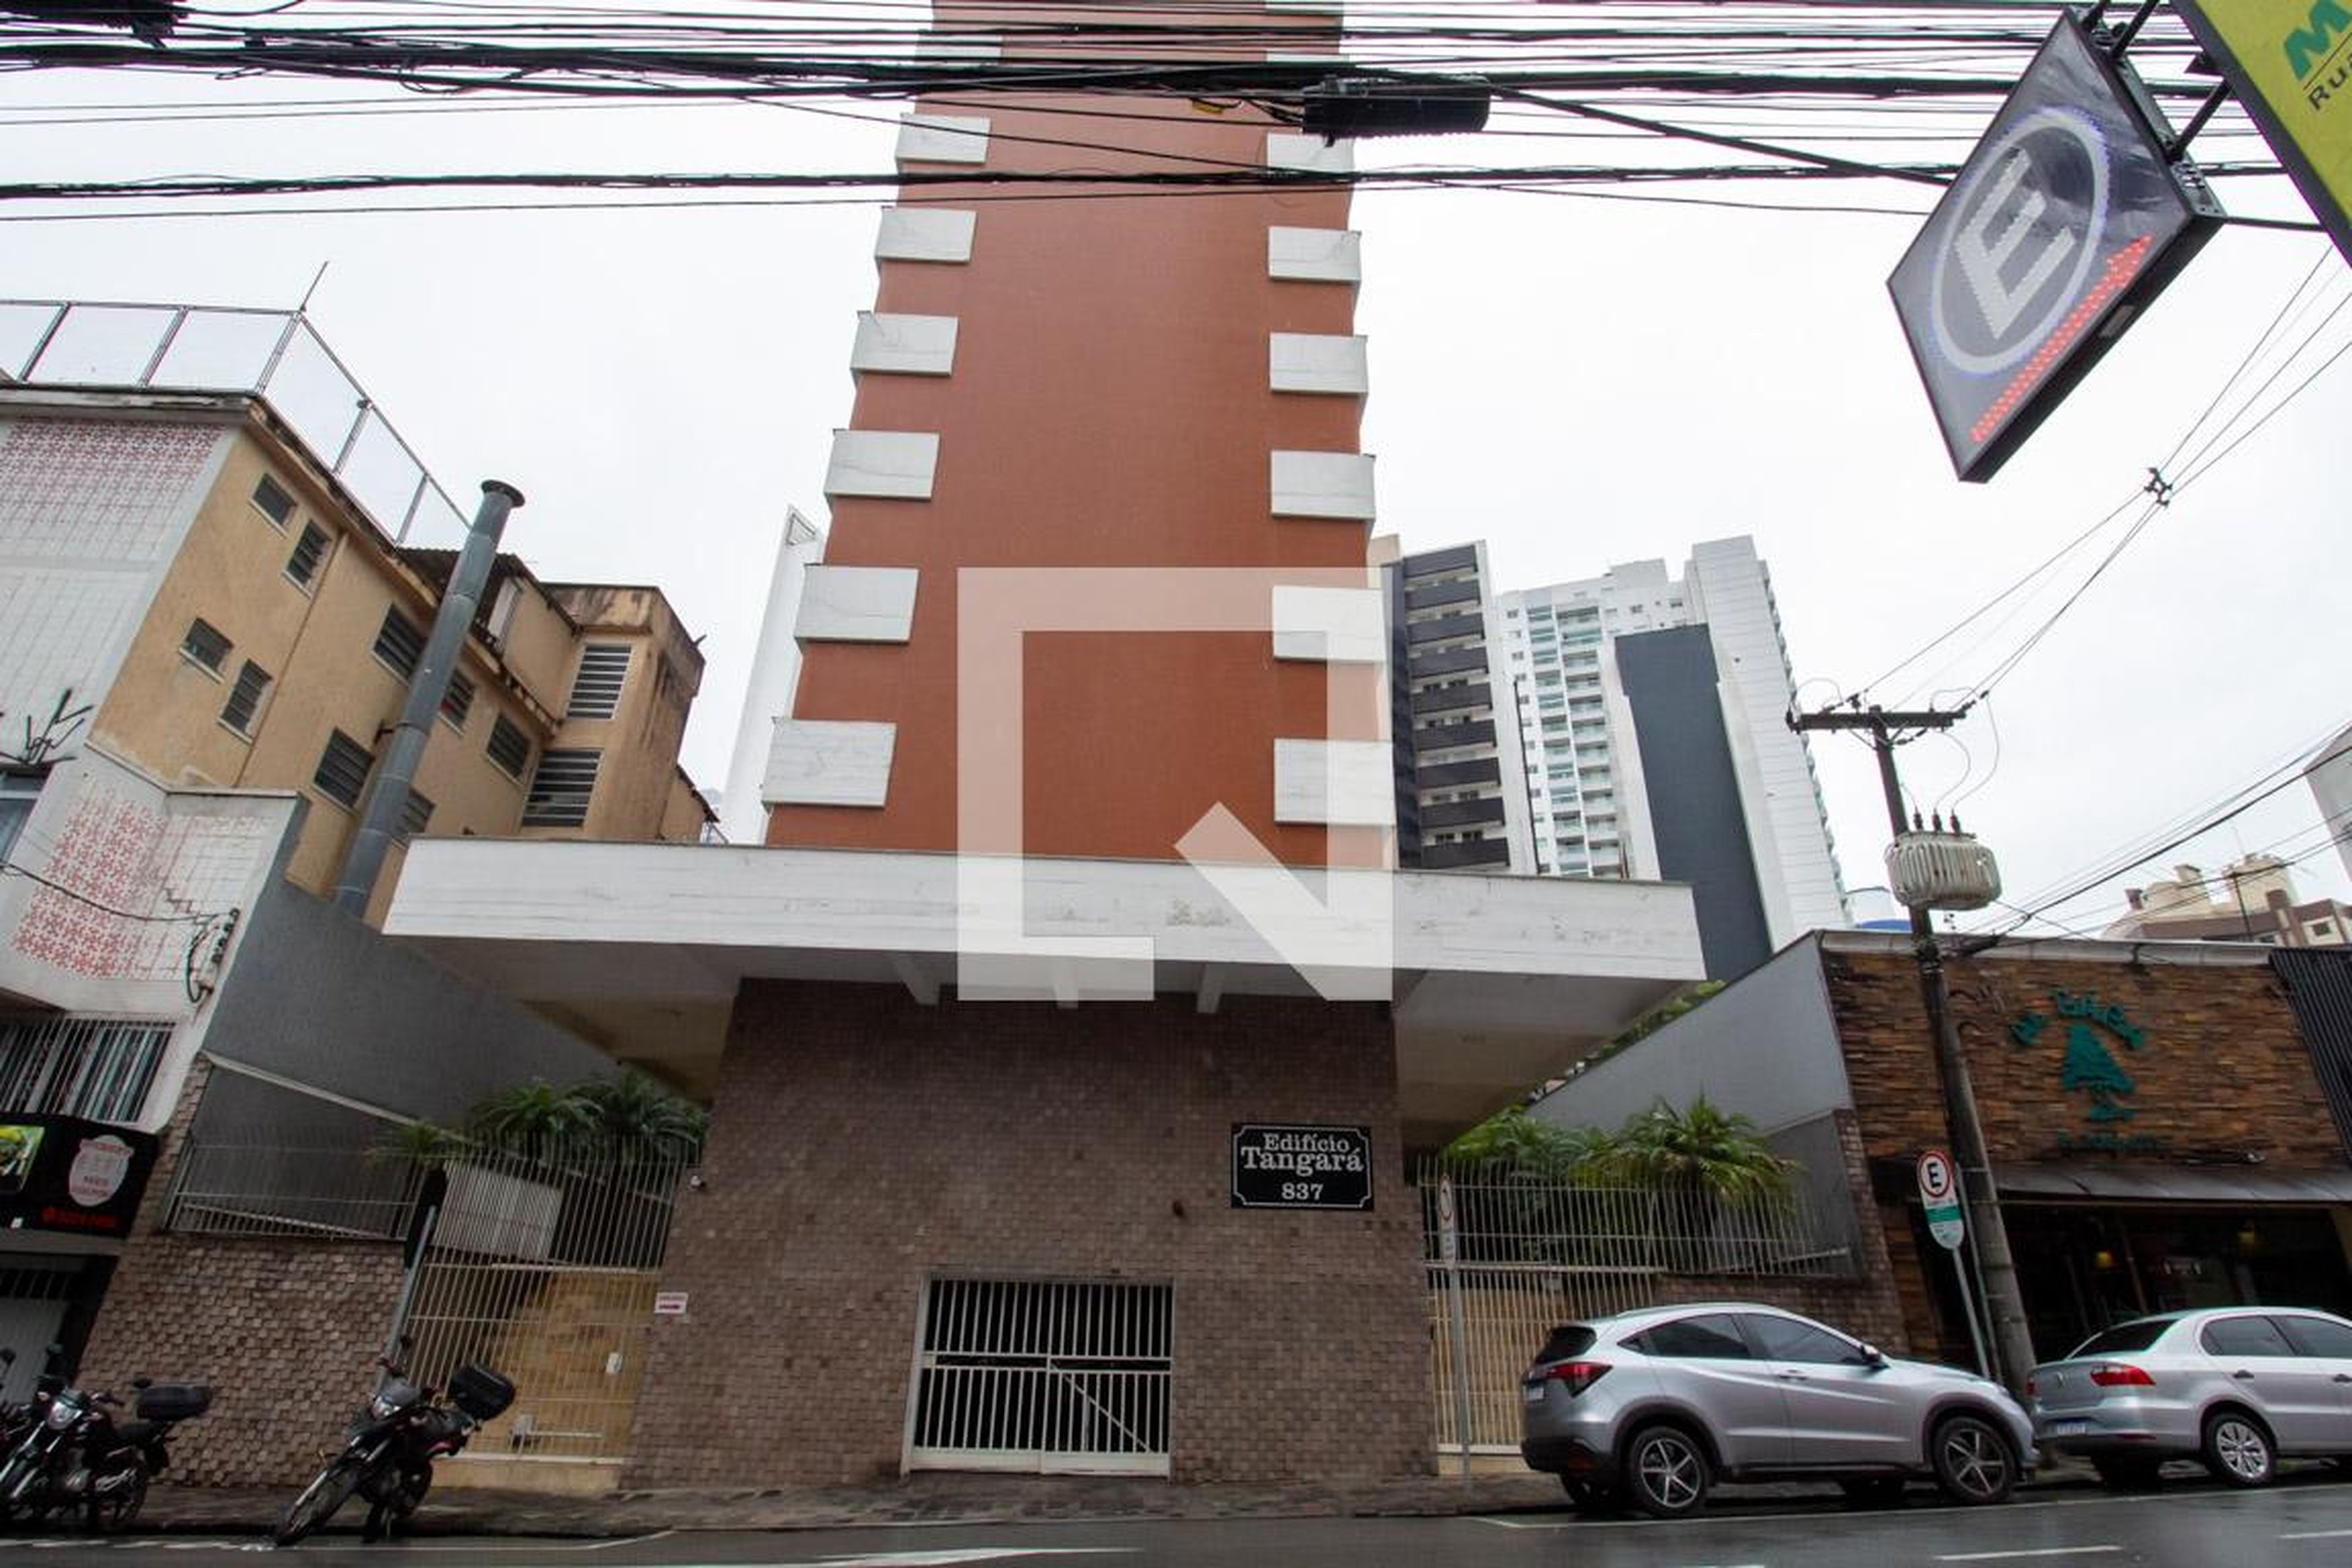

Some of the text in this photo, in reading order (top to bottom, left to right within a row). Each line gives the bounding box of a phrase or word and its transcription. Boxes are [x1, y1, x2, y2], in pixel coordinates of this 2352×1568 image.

[1954, 148, 2076, 339] E
[1263, 1133, 1349, 1152] Edifício
[1240, 1147, 1364, 1176] Tangará
[1928, 1163, 1942, 1188] E
[1281, 1183, 1323, 1200] 837
